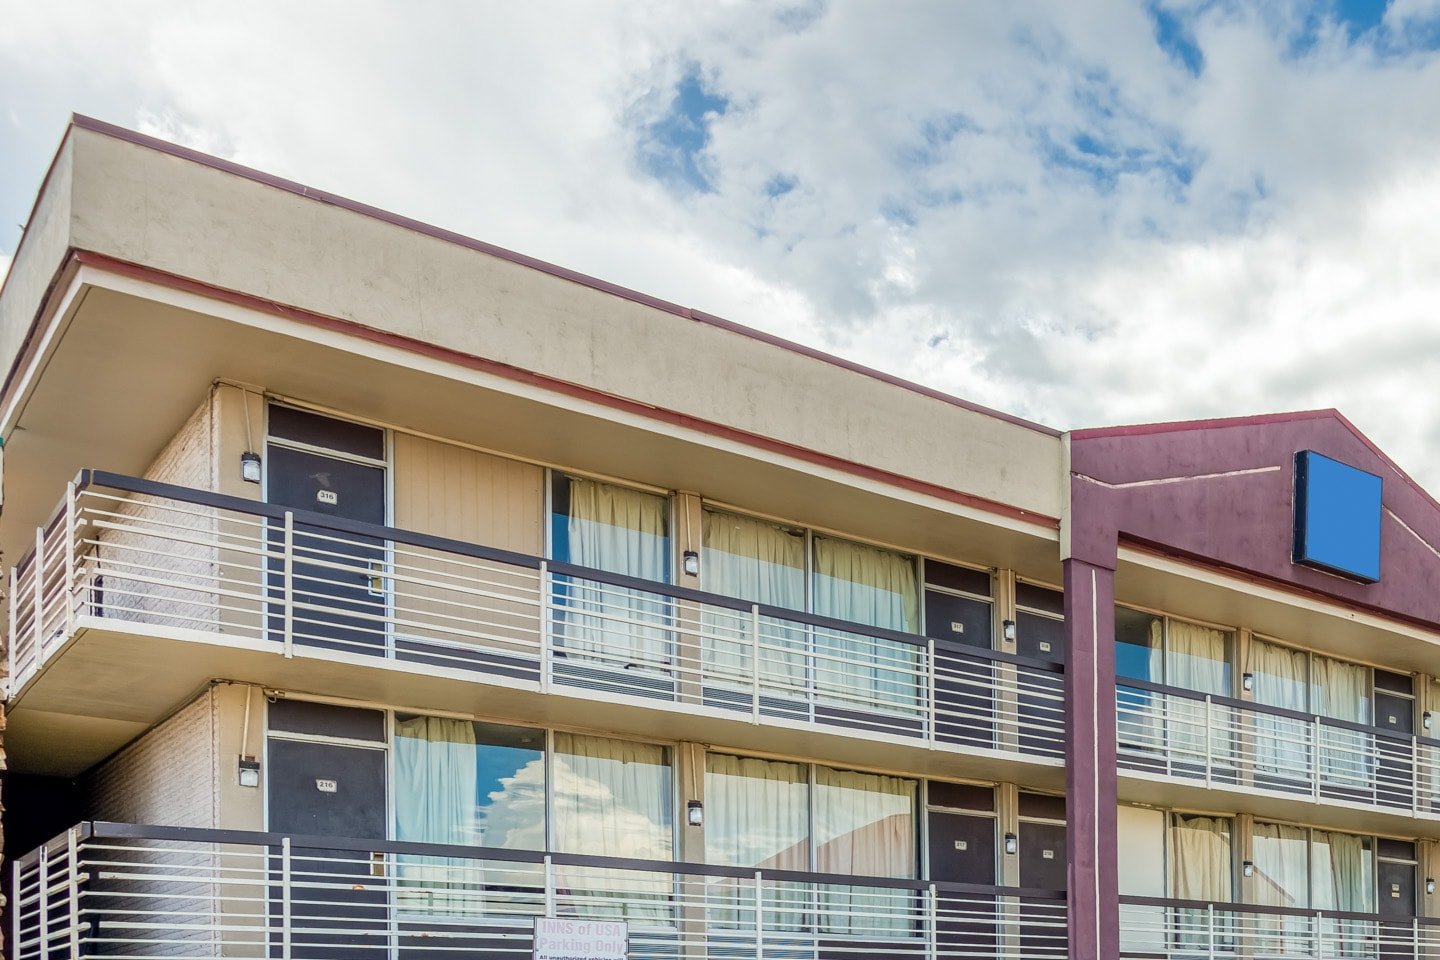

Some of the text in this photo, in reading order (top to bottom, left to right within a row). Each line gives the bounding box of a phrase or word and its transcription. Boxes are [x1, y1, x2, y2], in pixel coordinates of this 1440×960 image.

[319, 491, 334, 500] 316
[542, 921, 621, 936] INNS of USA
[540, 937, 624, 955] Parking Only
